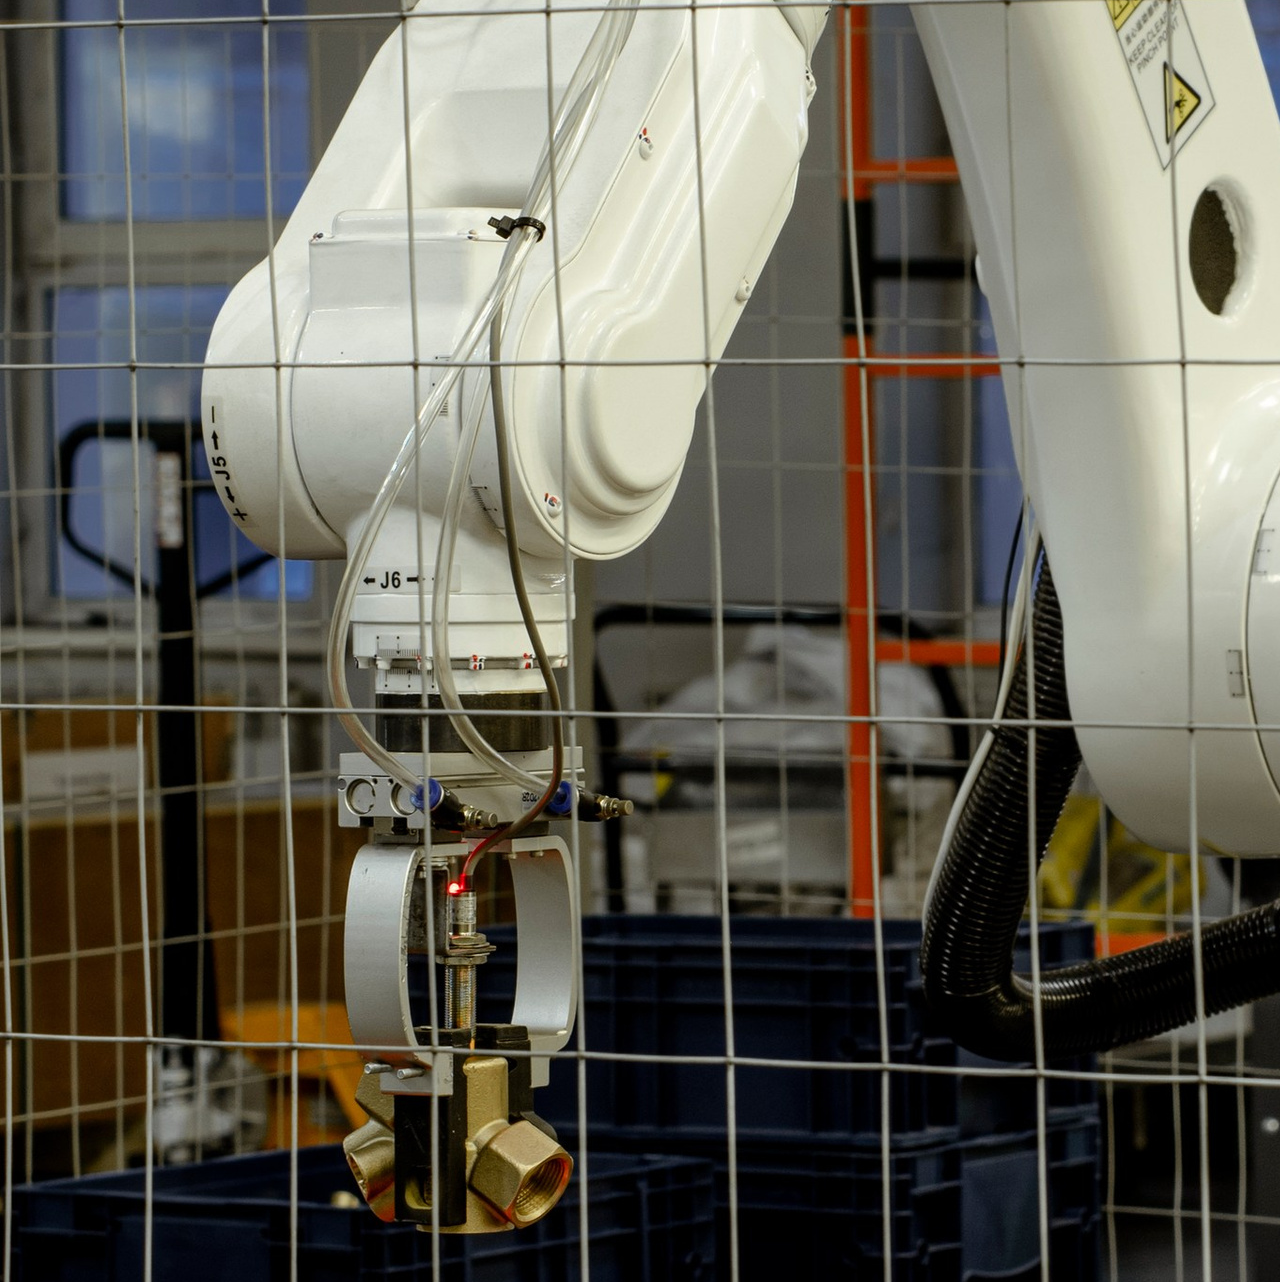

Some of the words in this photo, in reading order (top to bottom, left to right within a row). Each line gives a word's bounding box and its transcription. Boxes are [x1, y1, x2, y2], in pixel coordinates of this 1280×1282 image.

[1128, 39, 1146, 67] KEEP
[1136, 42, 1159, 74] PINCH
[1158, 16, 1179, 48] PONT
[212, 456, 231, 480] J5
[380, 571, 401, 589] J6
